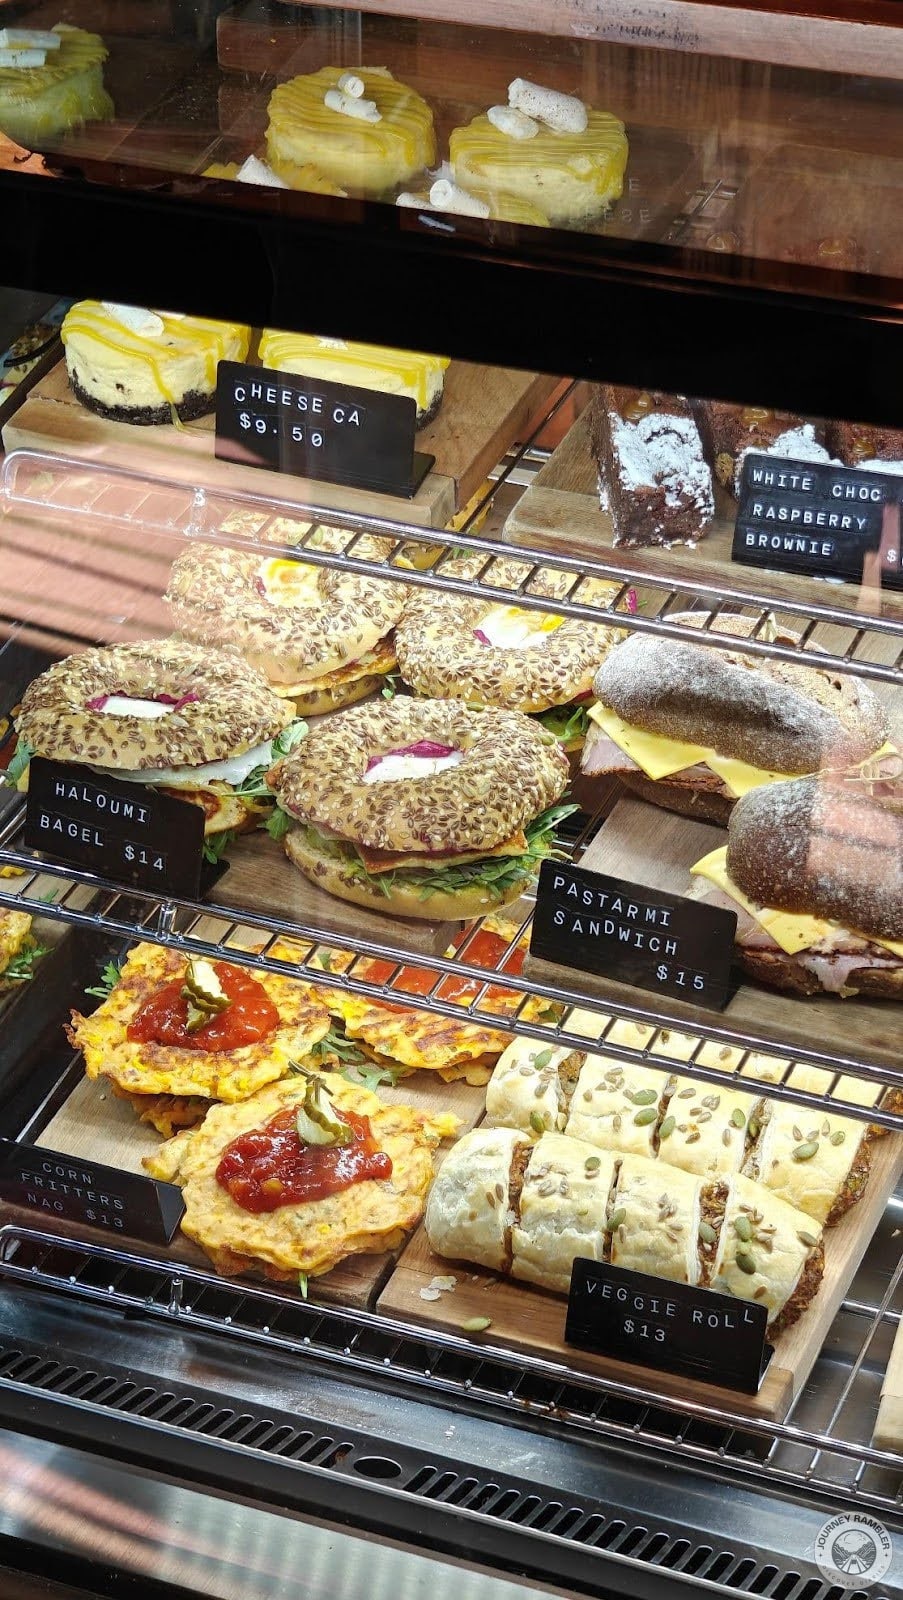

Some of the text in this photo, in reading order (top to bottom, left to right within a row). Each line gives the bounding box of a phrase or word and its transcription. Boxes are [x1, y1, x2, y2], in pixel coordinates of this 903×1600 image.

[234, 383, 361, 426] CHEESE CA
[239, 413, 323, 447] $9.50
[753, 469, 881, 501] WHITE CHOC
[752, 503, 867, 530] RASPBERRY
[746, 534, 832, 556] BROWNIE
[55, 782, 148, 823] HALOUMI
[40, 815, 164, 871] BAGEL $14
[553, 876, 671, 926] PASTARMI
[553, 910, 677, 956] SANDWICH
[656, 964, 705, 990] $15
[21, 1172, 124, 1210] FRITTERS
[42, 1162, 92, 1185] CORN
[27, 1193, 124, 1228] NAG $13
[586, 1280, 754, 1328] VEGGIE ROLL
[623, 1319, 666, 1342] $13
